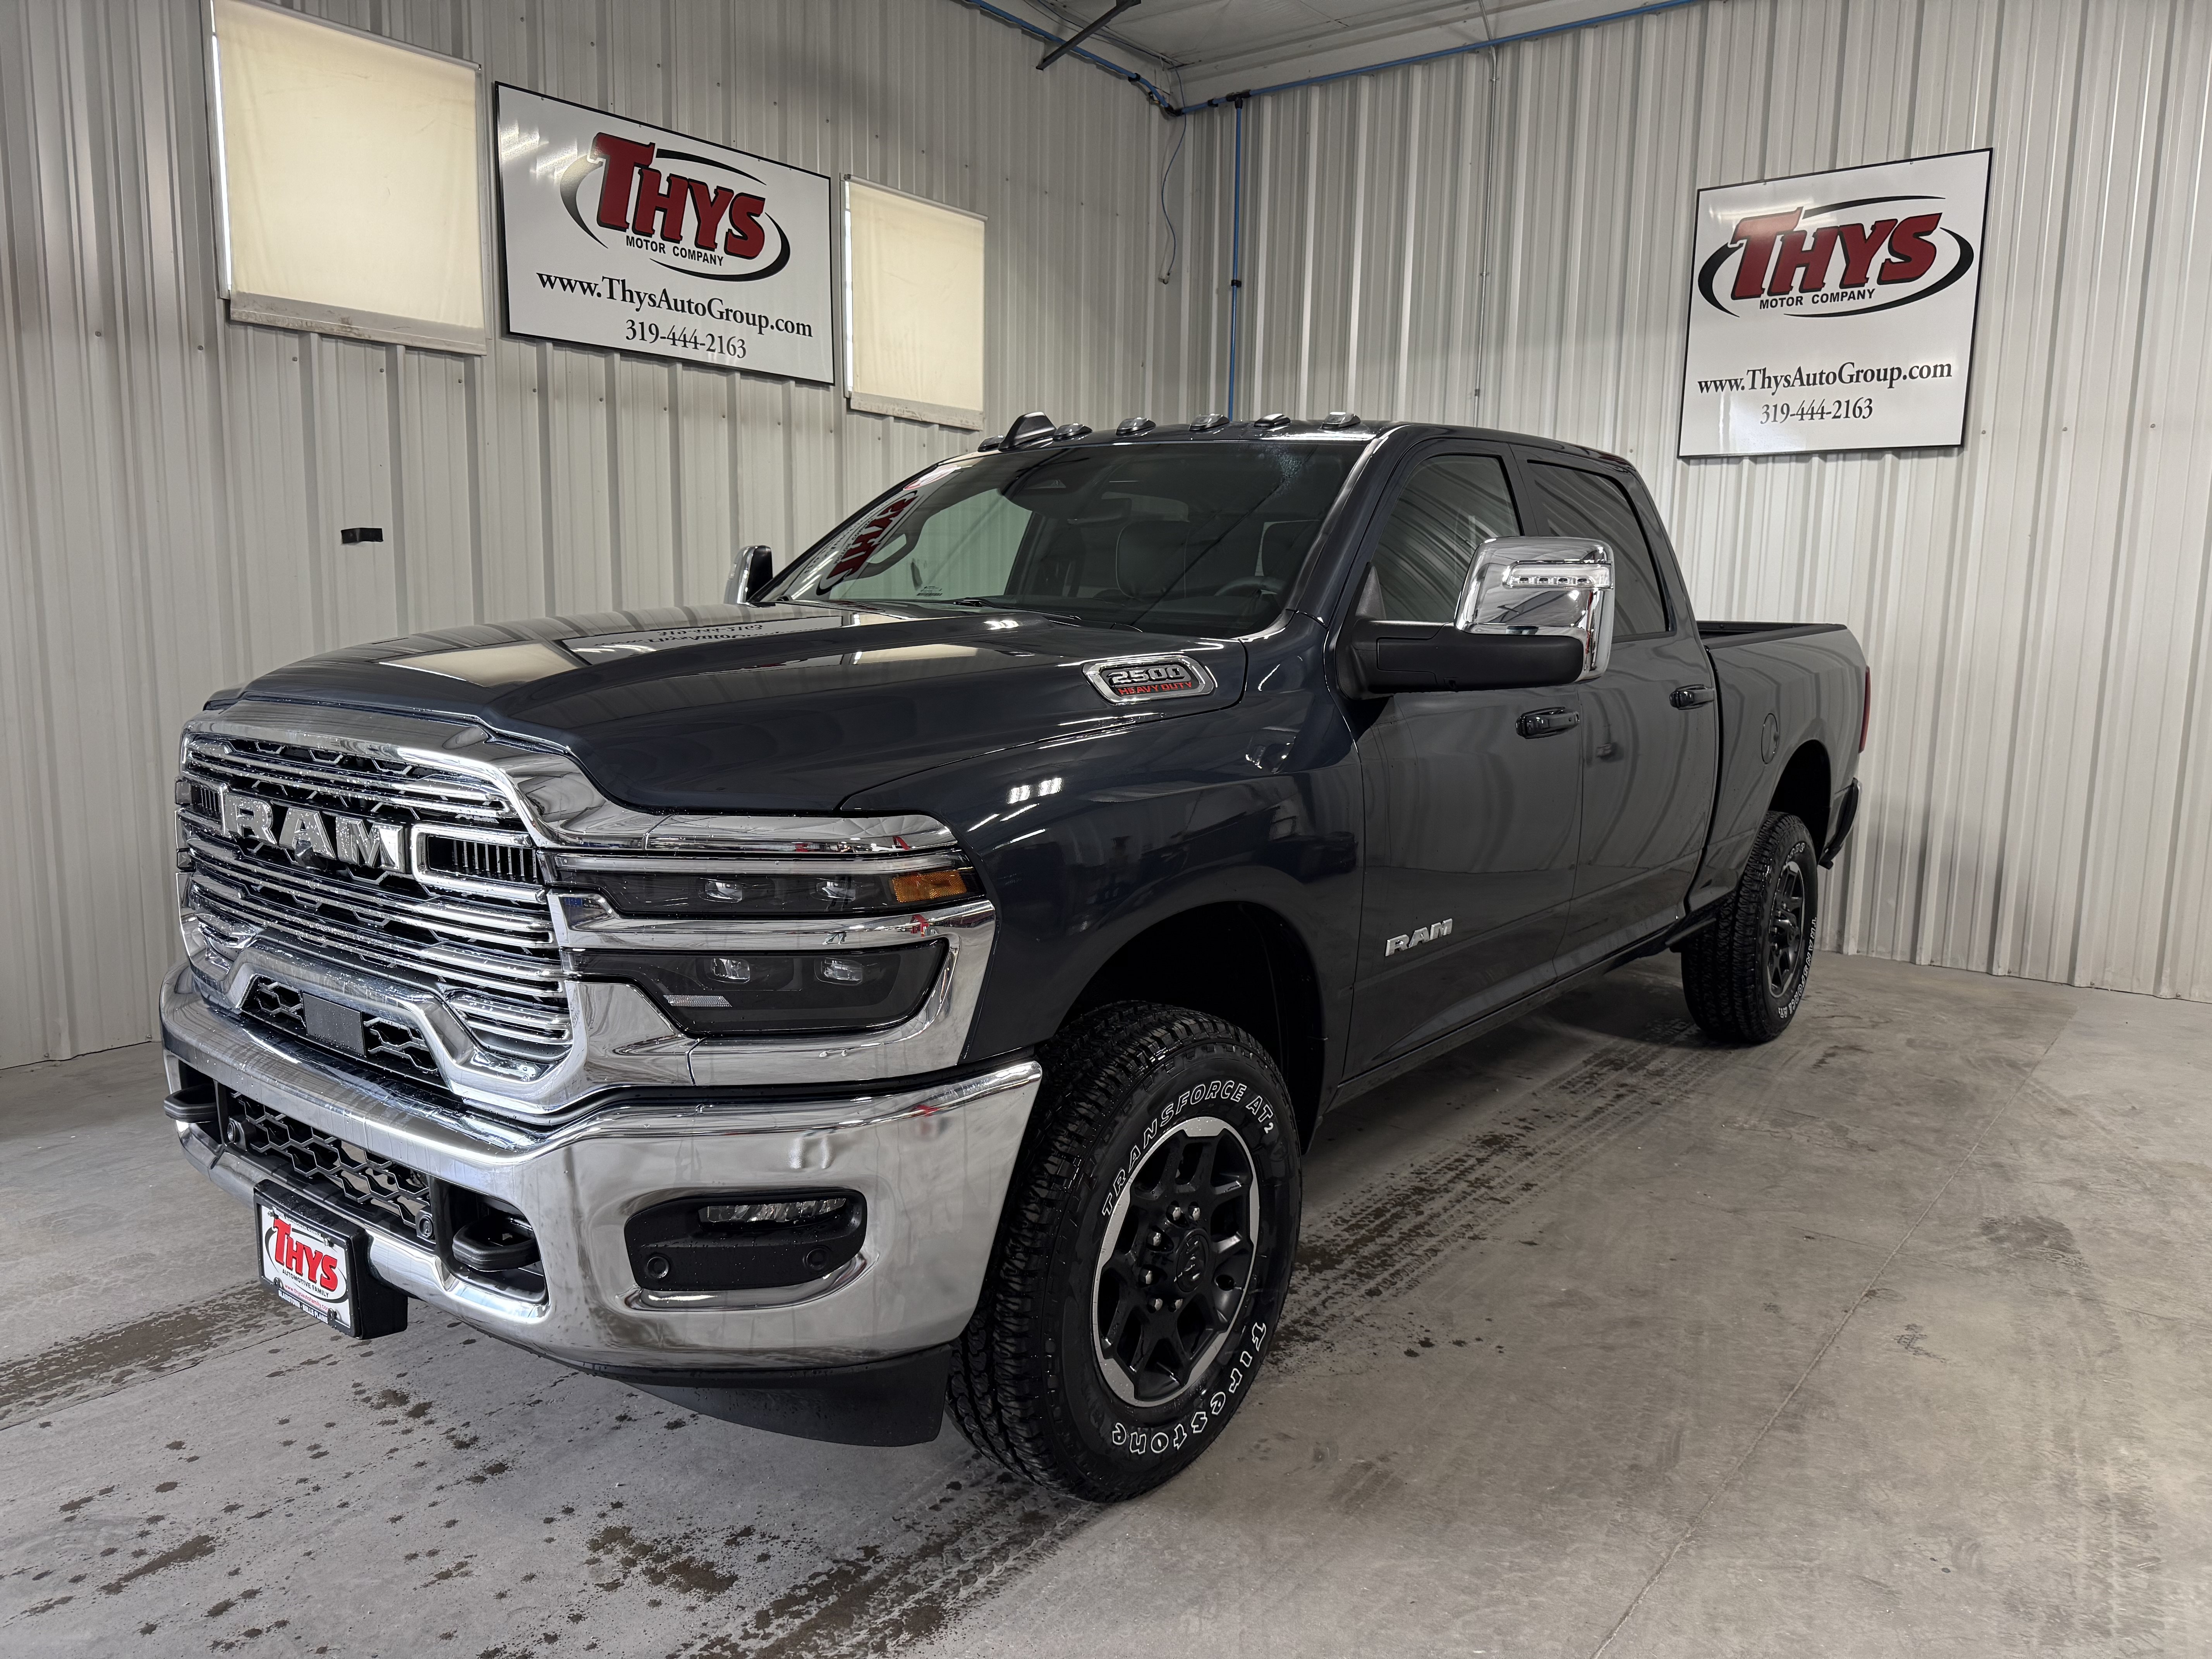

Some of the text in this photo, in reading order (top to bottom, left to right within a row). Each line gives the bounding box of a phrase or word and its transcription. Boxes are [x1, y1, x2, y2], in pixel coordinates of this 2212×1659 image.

[590, 132, 766, 260] THYS
[626, 235, 724, 266] MOTOR COMPANY
[1731, 207, 1942, 300] THYS
[536, 273, 813, 338] www.ThysAutoGroup.com
[1759, 289, 1876, 309] MOTOR COMPANY
[626, 319, 747, 359] 319-444-2163
[1698, 362, 1953, 395] www.ThysAutoGroup.com
[1760, 397, 1874, 424] 319-444-2163
[1106, 666, 1185, 686] 2500
[1118, 682, 1192, 695] HEAVY DUTY
[225, 793, 404, 874] RAM
[1385, 918, 1452, 957] RAM
[1101, 1080, 1248, 1217] TRANSFORCE
[273, 1218, 338, 1292] THYS
[283, 1268, 329, 1298] AUTOMOTIVE FAMILY
[1111, 1322, 1267, 1455] Firestone
